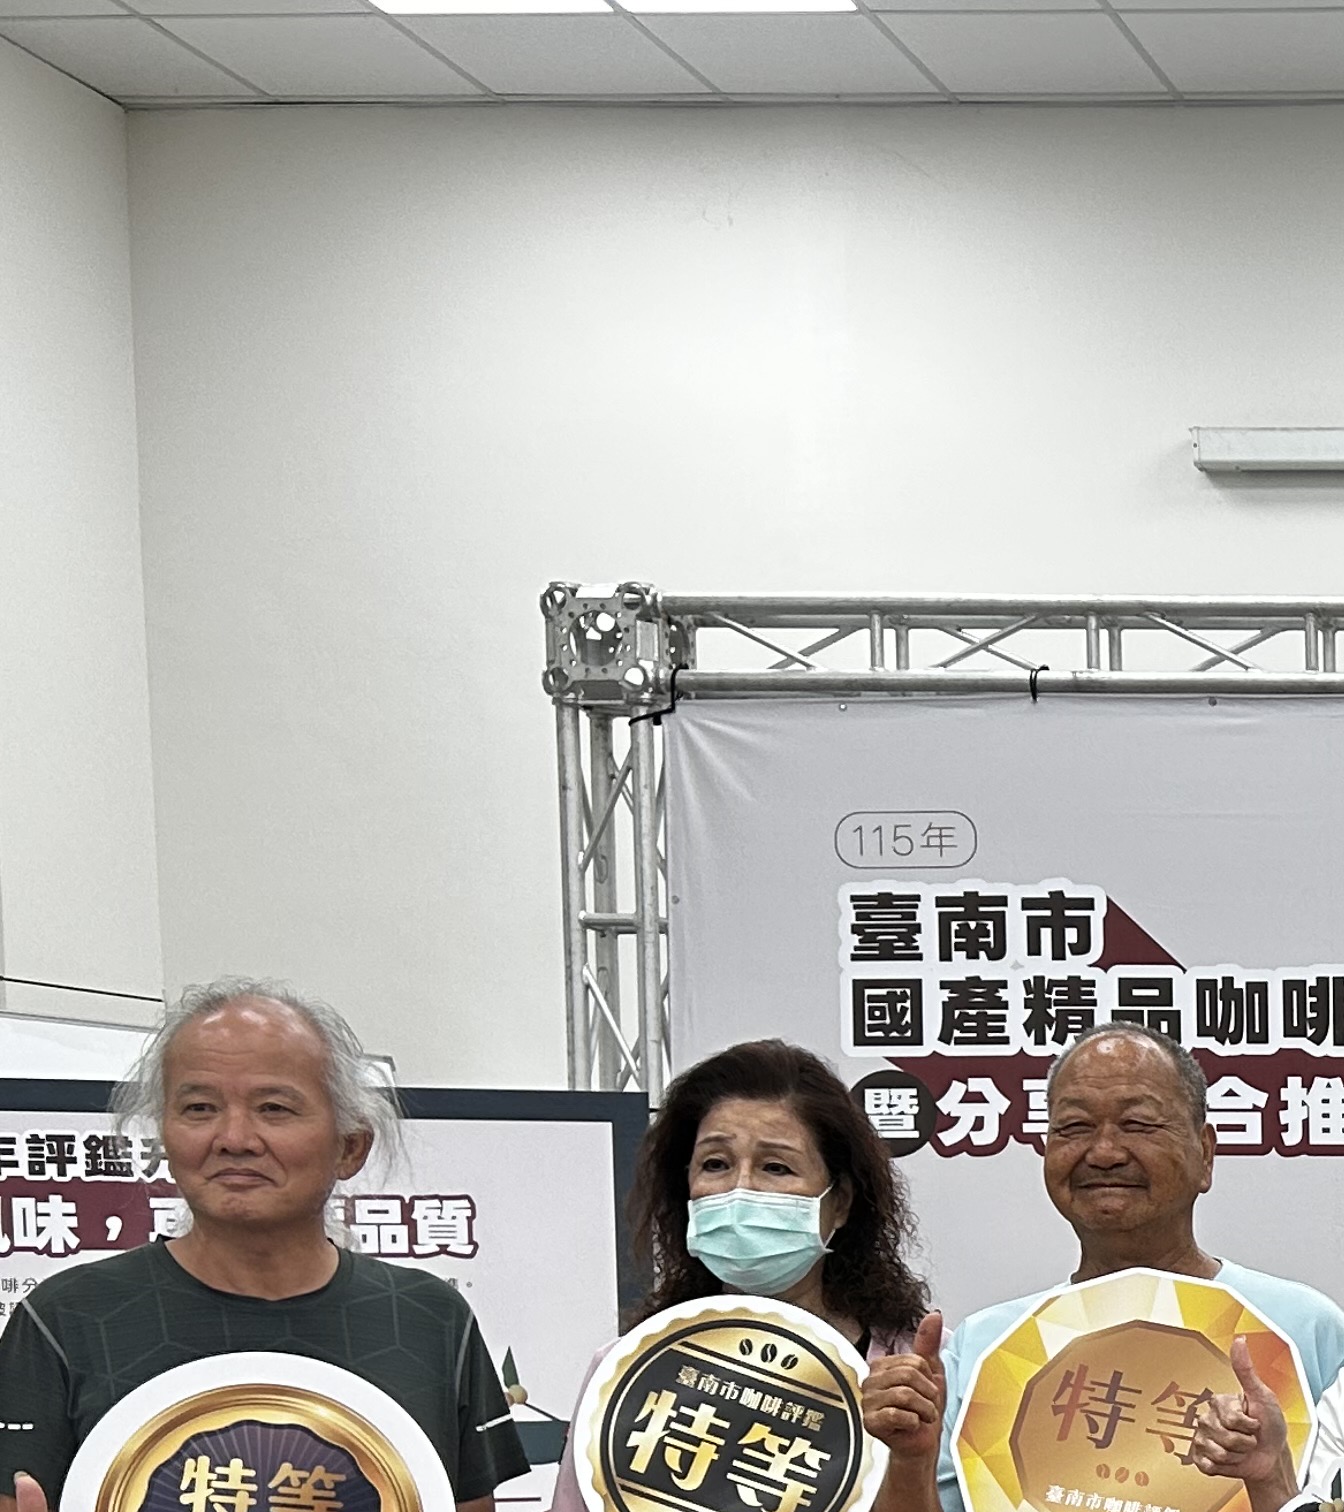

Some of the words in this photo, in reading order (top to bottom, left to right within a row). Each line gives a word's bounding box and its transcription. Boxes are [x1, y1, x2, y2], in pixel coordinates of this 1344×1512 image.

[852, 822, 958, 857] 115年
[850, 890, 1095, 962] 臺南市
[675, 1364, 825, 1432] 臺南市咖啡評鑑
[1052, 1363, 1216, 1466] 特等
